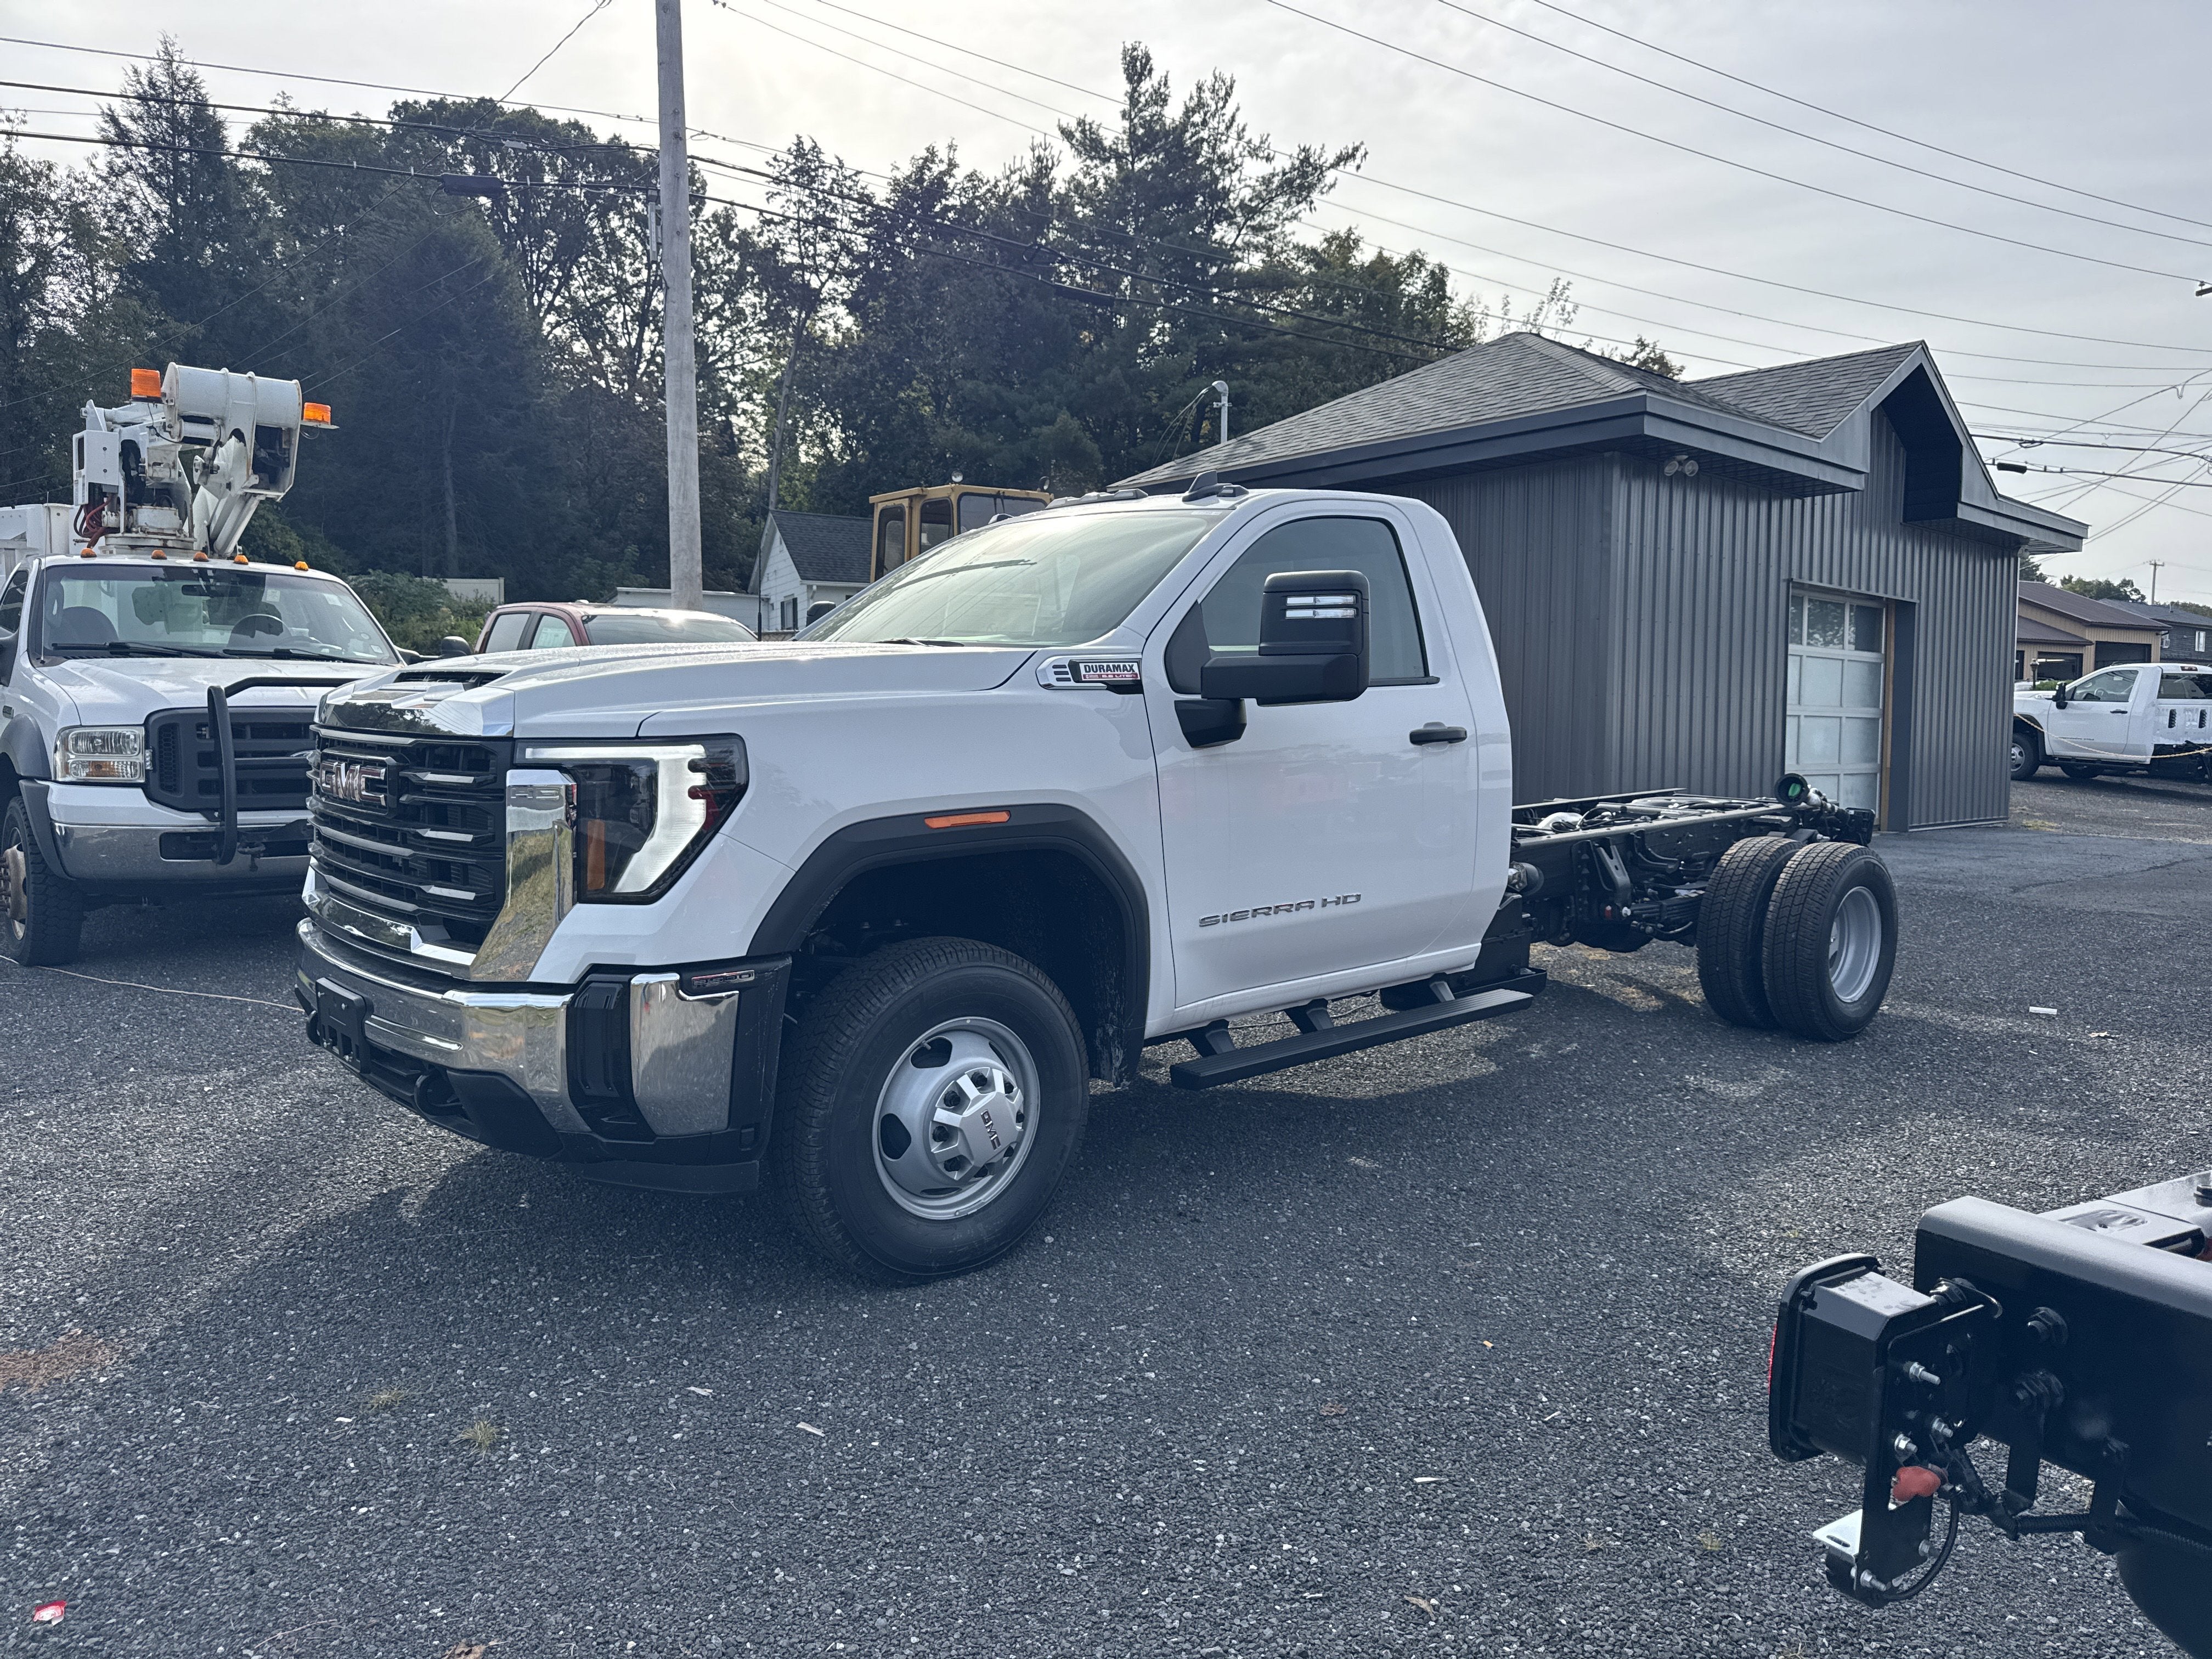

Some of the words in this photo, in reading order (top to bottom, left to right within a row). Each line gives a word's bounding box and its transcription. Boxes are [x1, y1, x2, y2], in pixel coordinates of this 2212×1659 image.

[1084, 664, 1136, 673] DURAMAX
[320, 760, 386, 806] GMC
[510, 788, 560, 799] HD
[1199, 900, 1315, 927] SIERRA
[1321, 893, 1362, 908] HD
[980, 1109, 1002, 1151] GMC
